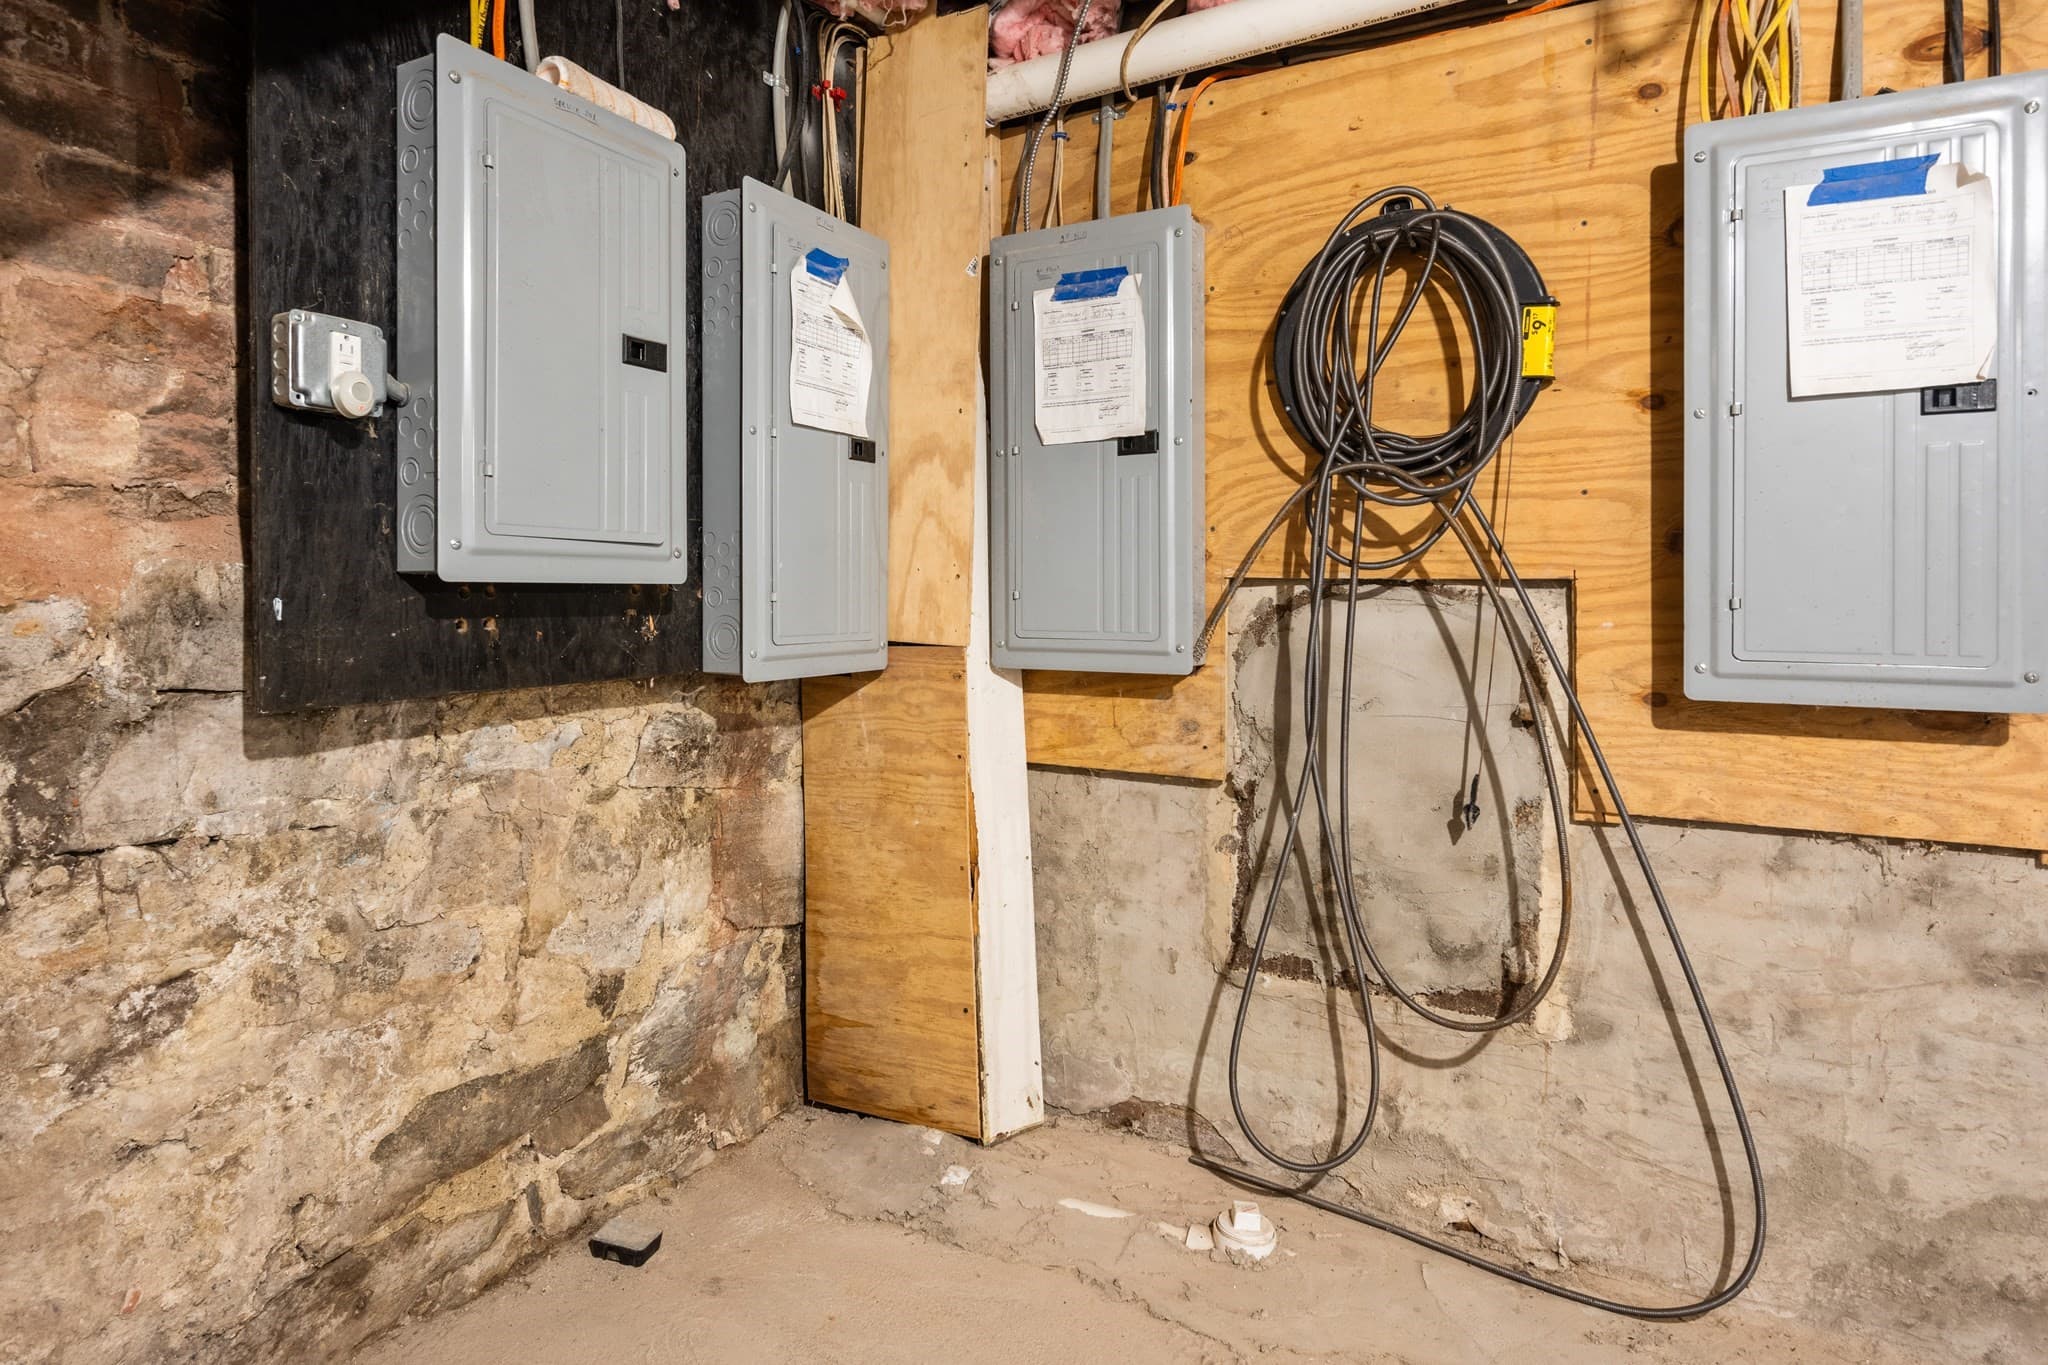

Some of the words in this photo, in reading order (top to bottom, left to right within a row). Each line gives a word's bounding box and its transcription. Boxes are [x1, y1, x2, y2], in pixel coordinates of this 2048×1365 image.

[1214, 55, 1237, 65] ASTM
[1364, 15, 1389, 25] Code
[1391, 8, 1417, 18] JM90
